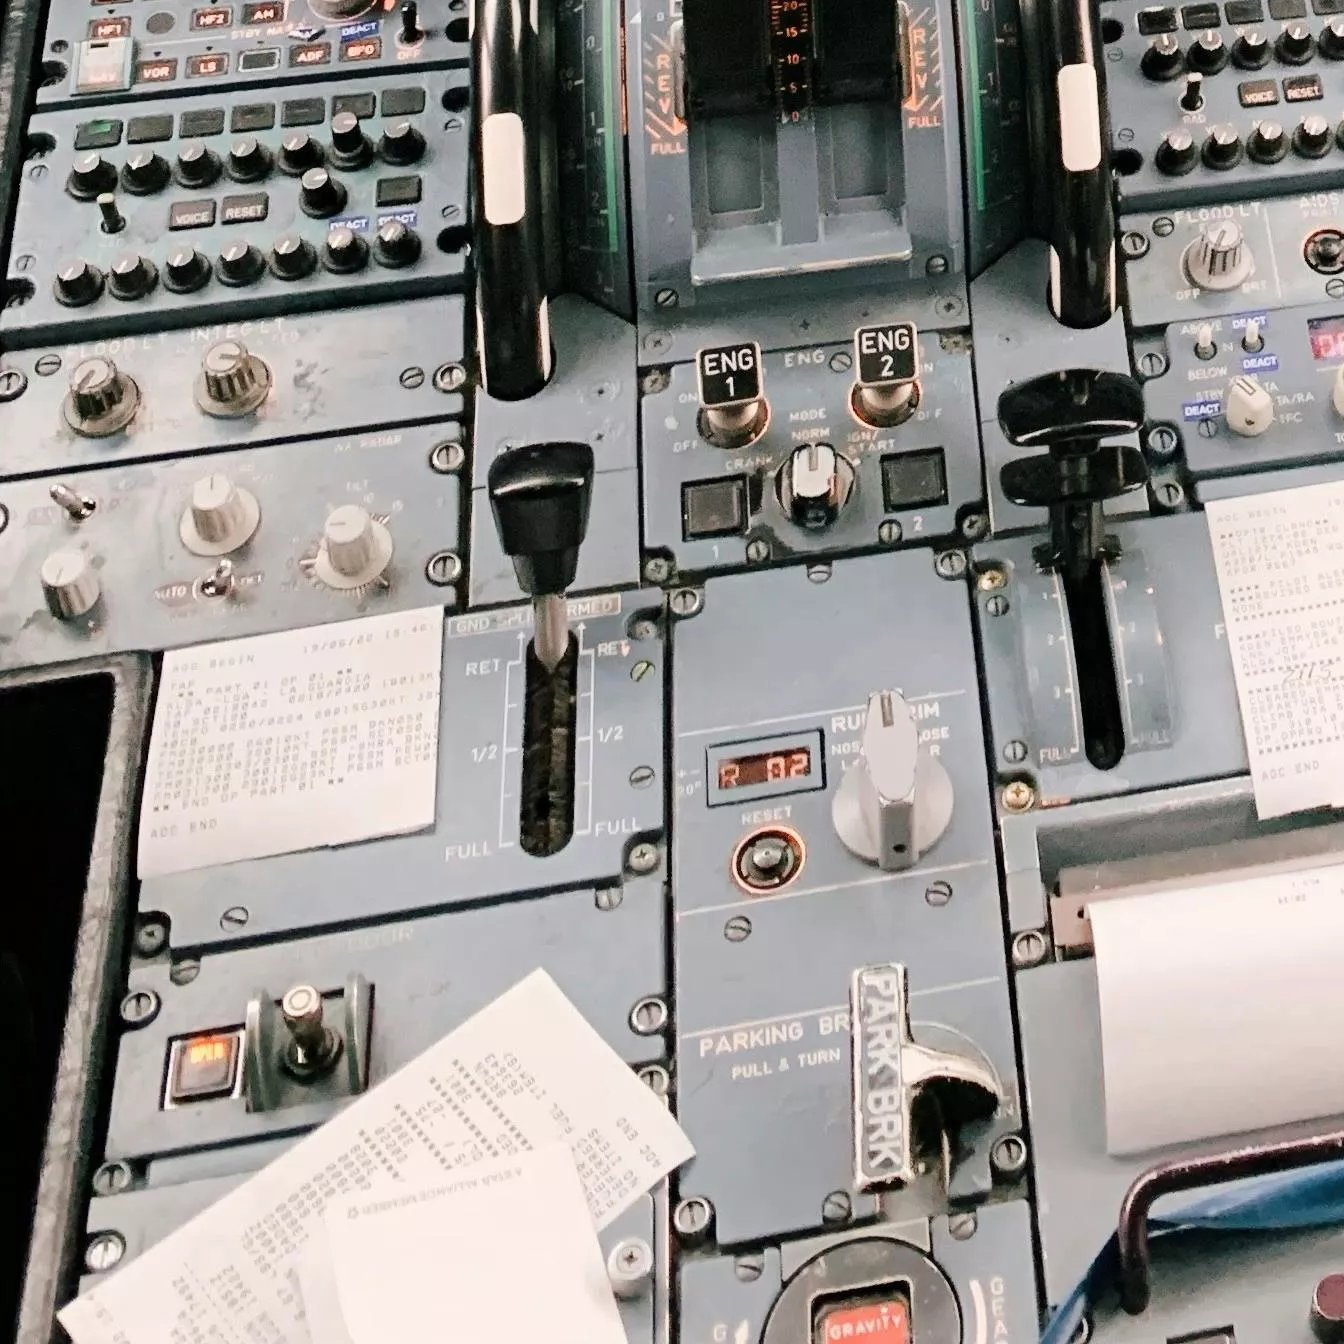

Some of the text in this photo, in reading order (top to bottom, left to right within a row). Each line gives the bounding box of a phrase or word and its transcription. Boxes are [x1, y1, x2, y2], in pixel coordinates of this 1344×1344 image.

[296, 49, 324, 62] ADF
[143, 67, 169, 79] VOR
[175, 211, 210, 224] VOICE
[225, 205, 263, 218] RESET
[1174, 203, 1262, 223] FLOOD LT
[861, 329, 910, 354] ENG
[704, 349, 753, 376] ENG
[784, 350, 825, 367] ENG
[881, 355, 893, 377] 2
[1243, 355, 1278, 370] DEACT
[726, 378, 734, 396] 1
[789, 409, 826, 421] MODE
[792, 428, 830, 440] NORM
[725, 456, 772, 470] CRANK
[465, 660, 501, 676] RET
[597, 727, 625, 742] 1/2
[472, 745, 499, 762] 1/2
[741, 806, 793, 825] RESET
[595, 818, 642, 835] FULL
[445, 844, 492, 860] FULL
[700, 1023, 804, 1057] PARKING
[732, 1048, 841, 1080] PULL & TURN
[862, 974, 902, 1170] PARK BRK
[829, 1313, 902, 1341] GRAVITY
